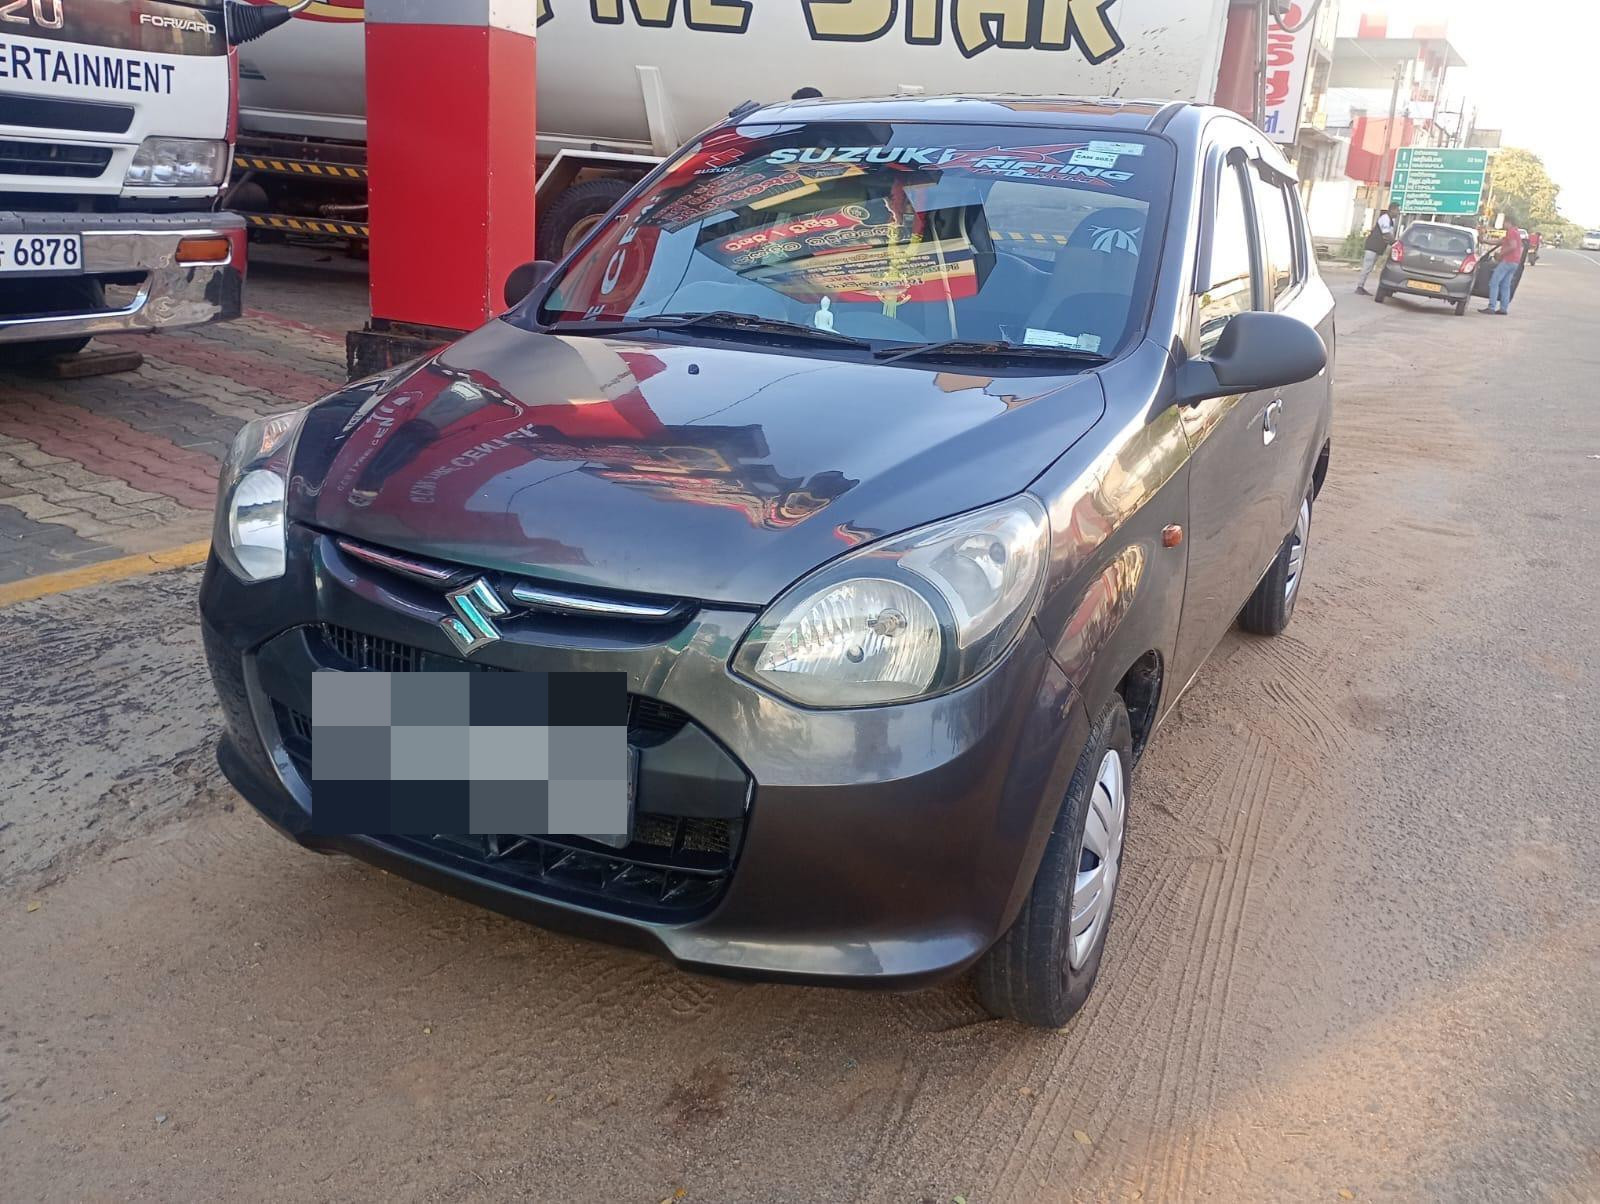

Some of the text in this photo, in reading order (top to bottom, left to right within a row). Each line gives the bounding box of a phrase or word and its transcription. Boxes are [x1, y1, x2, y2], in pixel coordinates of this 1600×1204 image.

[140, 13, 216, 35] FORWARD
[693, 166, 737, 176] SUZUKI
[14, 238, 78, 266] 6878
